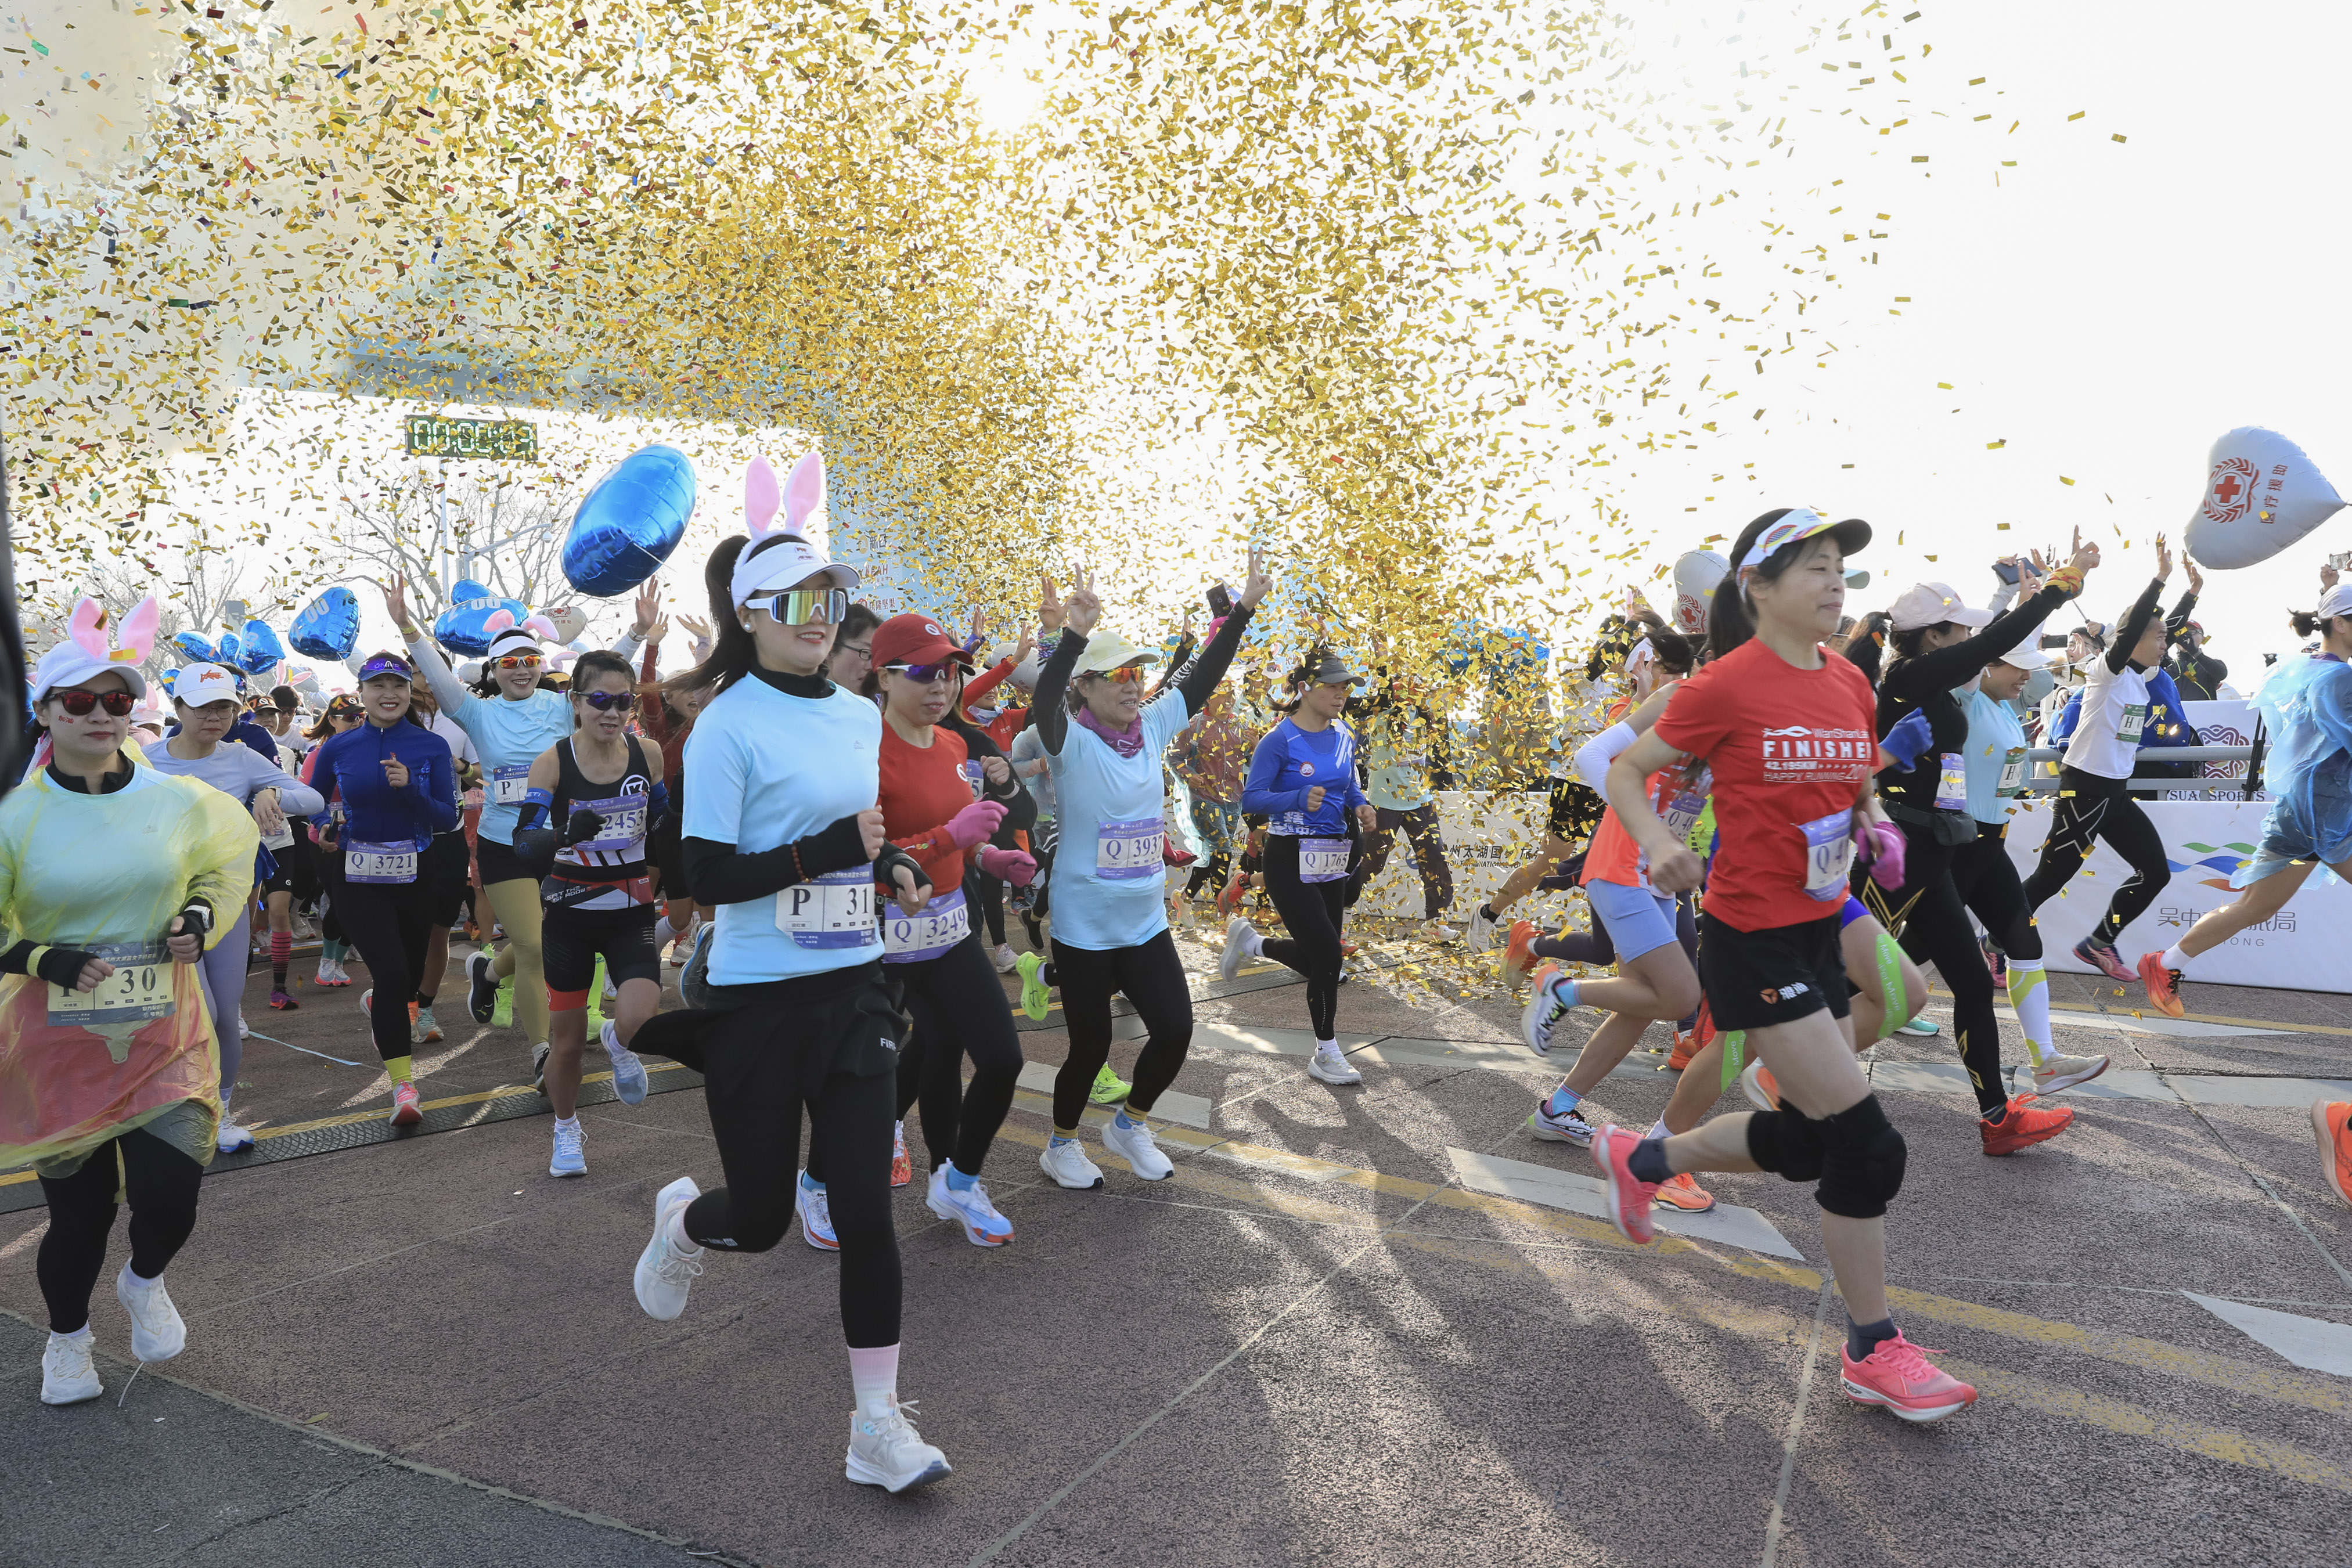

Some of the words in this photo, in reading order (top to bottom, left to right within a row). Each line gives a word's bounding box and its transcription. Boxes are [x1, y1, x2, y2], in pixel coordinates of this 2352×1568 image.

[59, 715, 74, 724] 加油
[2124, 716, 2134, 729] H
[1763, 771, 1804, 781] HAPPY
[1805, 772, 1846, 781] RUNNING
[2005, 765, 2016, 780] H
[501, 781, 511, 795] P
[2209, 790, 2265, 802] SPORS
[603, 809, 644, 830] 2453
[1106, 839, 1122, 860] Q
[1133, 834, 1163, 857] 3937
[351, 853, 364, 870] Q
[375, 854, 413, 870] 3721
[1305, 852, 1316, 868] Q
[1324, 853, 1348, 867] 1765
[1817, 845, 1830, 874] Q
[566, 885, 581, 893] THE
[789, 888, 811, 916] P
[847, 887, 869, 915] 31
[894, 920, 912, 943] Q
[926, 907, 966, 939] 3249
[1879, 944, 1893, 965] Move
[120, 967, 156, 994] 30
[1885, 981, 1901, 1011] Move
[1731, 1040, 1740, 1066] Move
